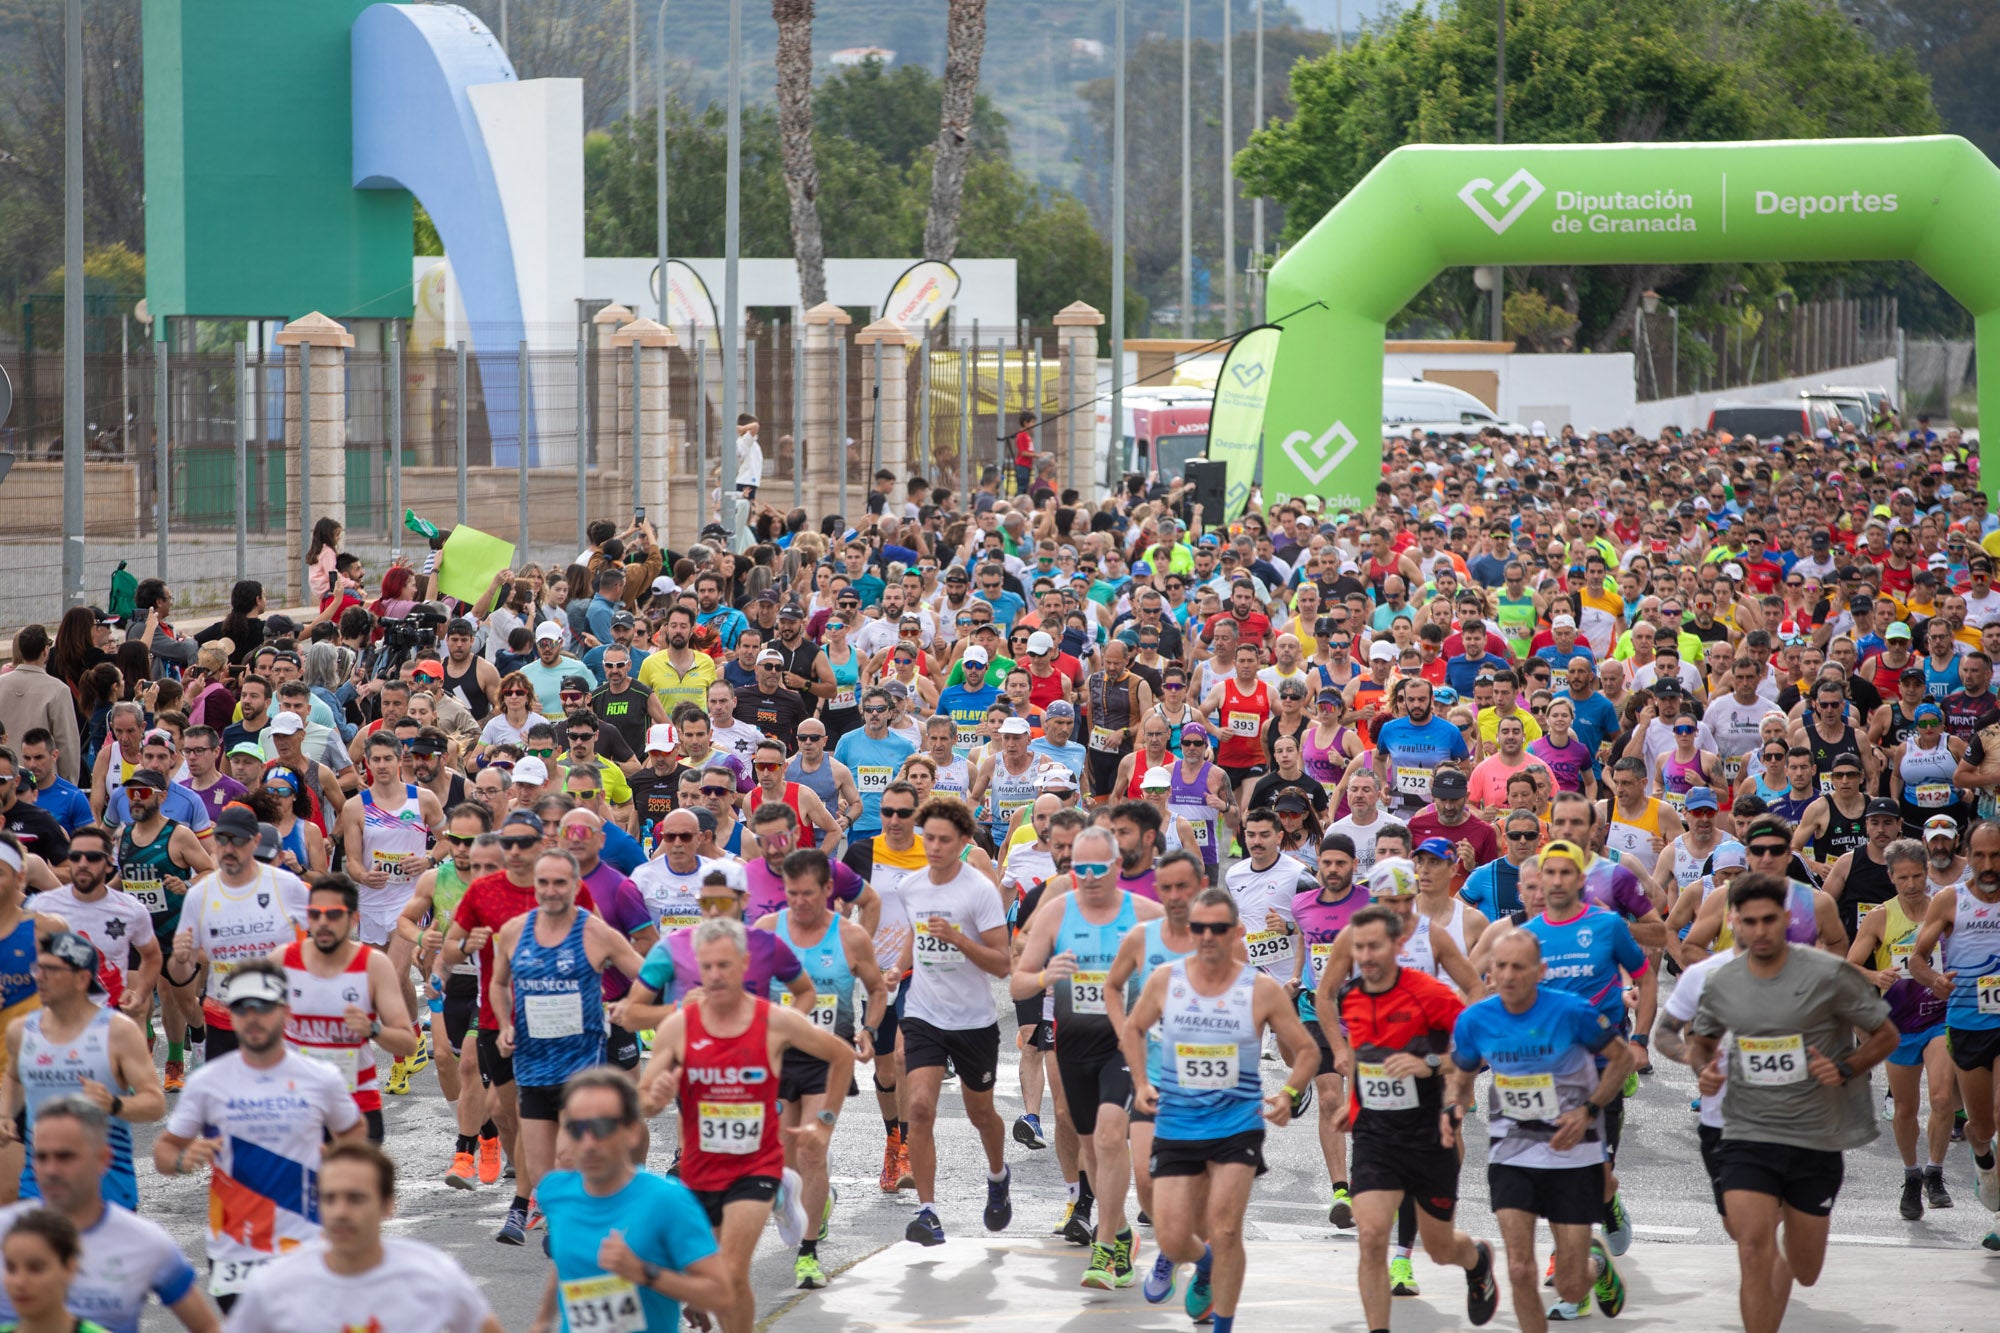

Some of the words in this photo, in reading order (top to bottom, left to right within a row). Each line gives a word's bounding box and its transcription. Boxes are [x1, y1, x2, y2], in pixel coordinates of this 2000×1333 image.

[1555, 189, 1694, 212] Diputación
[1755, 189, 1898, 219] Deportes
[1551, 214, 1582, 234] de
[1588, 212, 1697, 234] Granada
[606, 705, 628, 716] RUN
[1233, 721, 1254, 731] 393
[863, 775, 887, 785] 994
[1402, 776, 1425, 788] 732
[997, 785, 1035, 793] MARACENA
[648, 803, 671, 812] 2025
[1249, 937, 1290, 958] 3293
[1173, 1015, 1240, 1030] MARACENA
[1186, 1061, 1229, 1077] 533
[1750, 1054, 1794, 1072] 546
[1366, 1080, 1405, 1097] 296
[1505, 1091, 1545, 1109] 851
[703, 1120, 759, 1139] 3194
[570, 1297, 637, 1328] 3314
